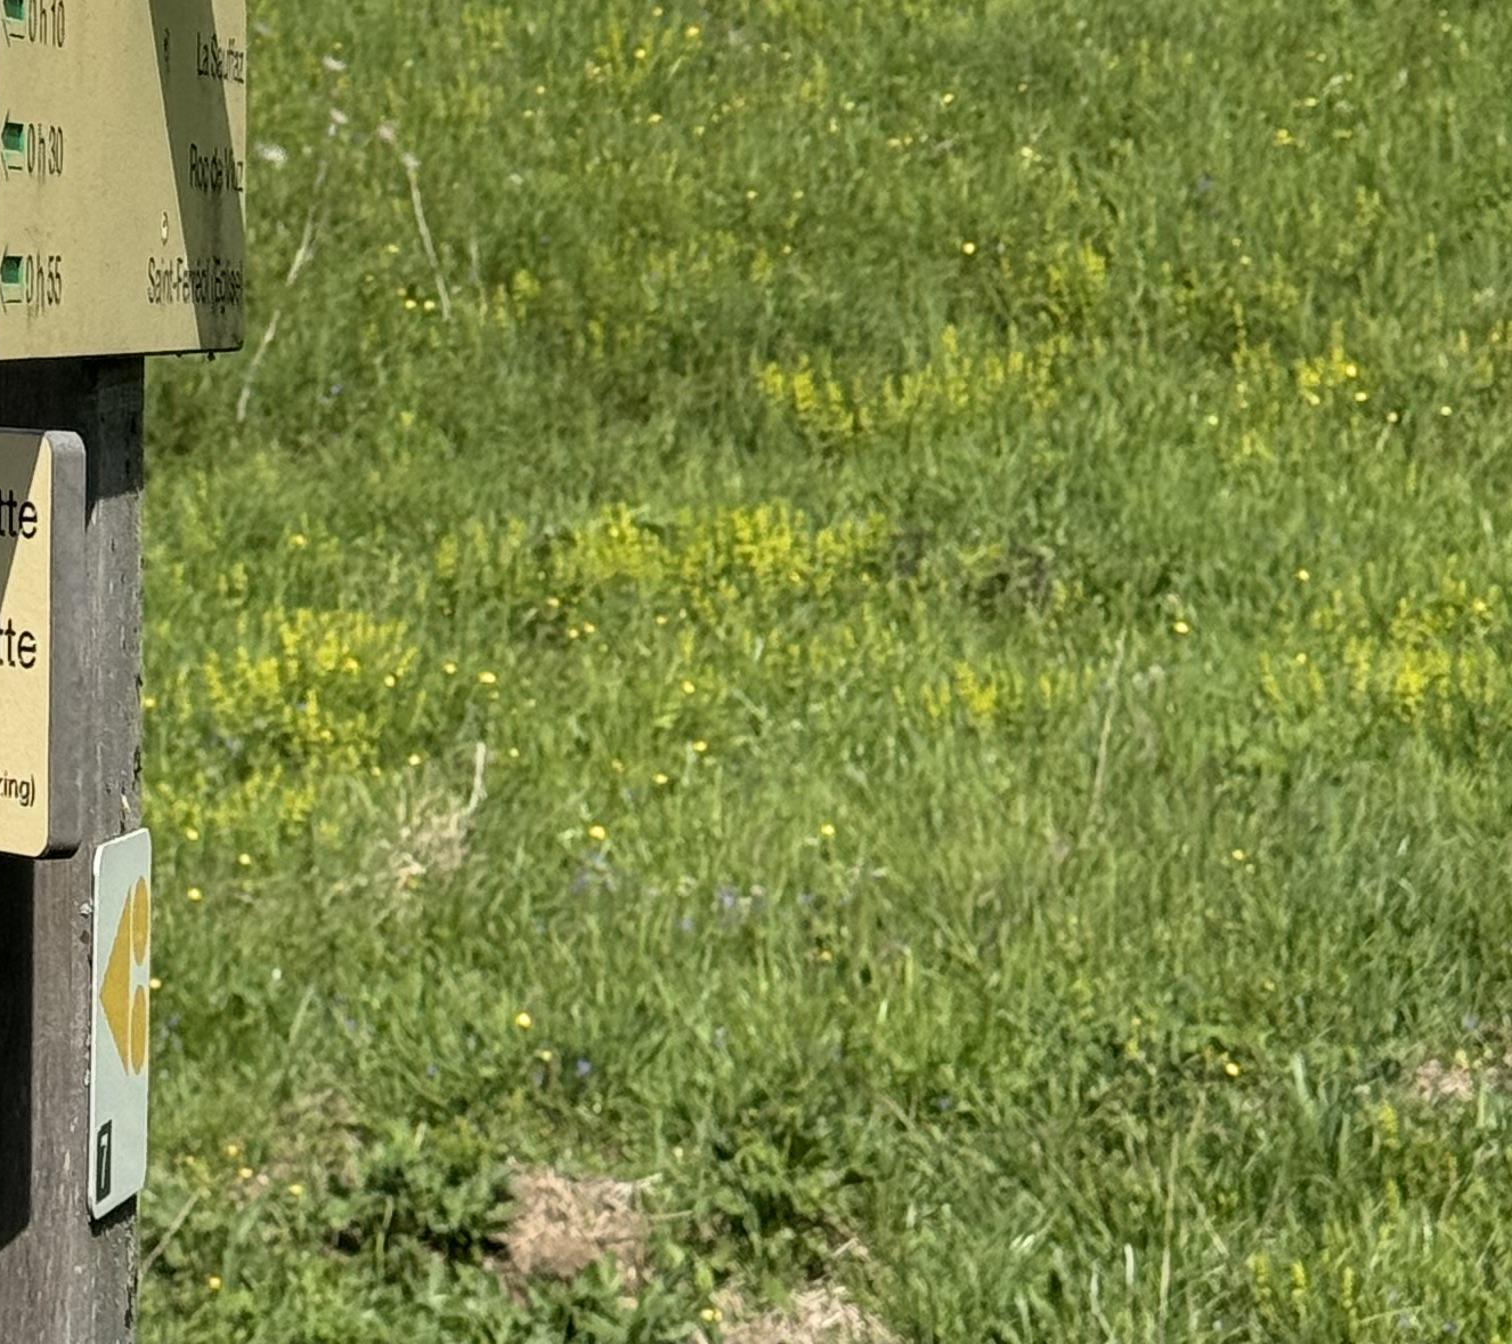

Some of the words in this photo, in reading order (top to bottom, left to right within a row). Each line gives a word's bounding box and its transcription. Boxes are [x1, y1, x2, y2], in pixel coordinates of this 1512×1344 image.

[195, 31, 209, 76] La
[27, 123, 36, 174] 0
[38, 124, 46, 177] h
[48, 125, 64, 176] 30
[210, 146, 223, 194] de
[25, 254, 34, 304] 0
[36, 254, 45, 310] h
[47, 255, 63, 306] 55
